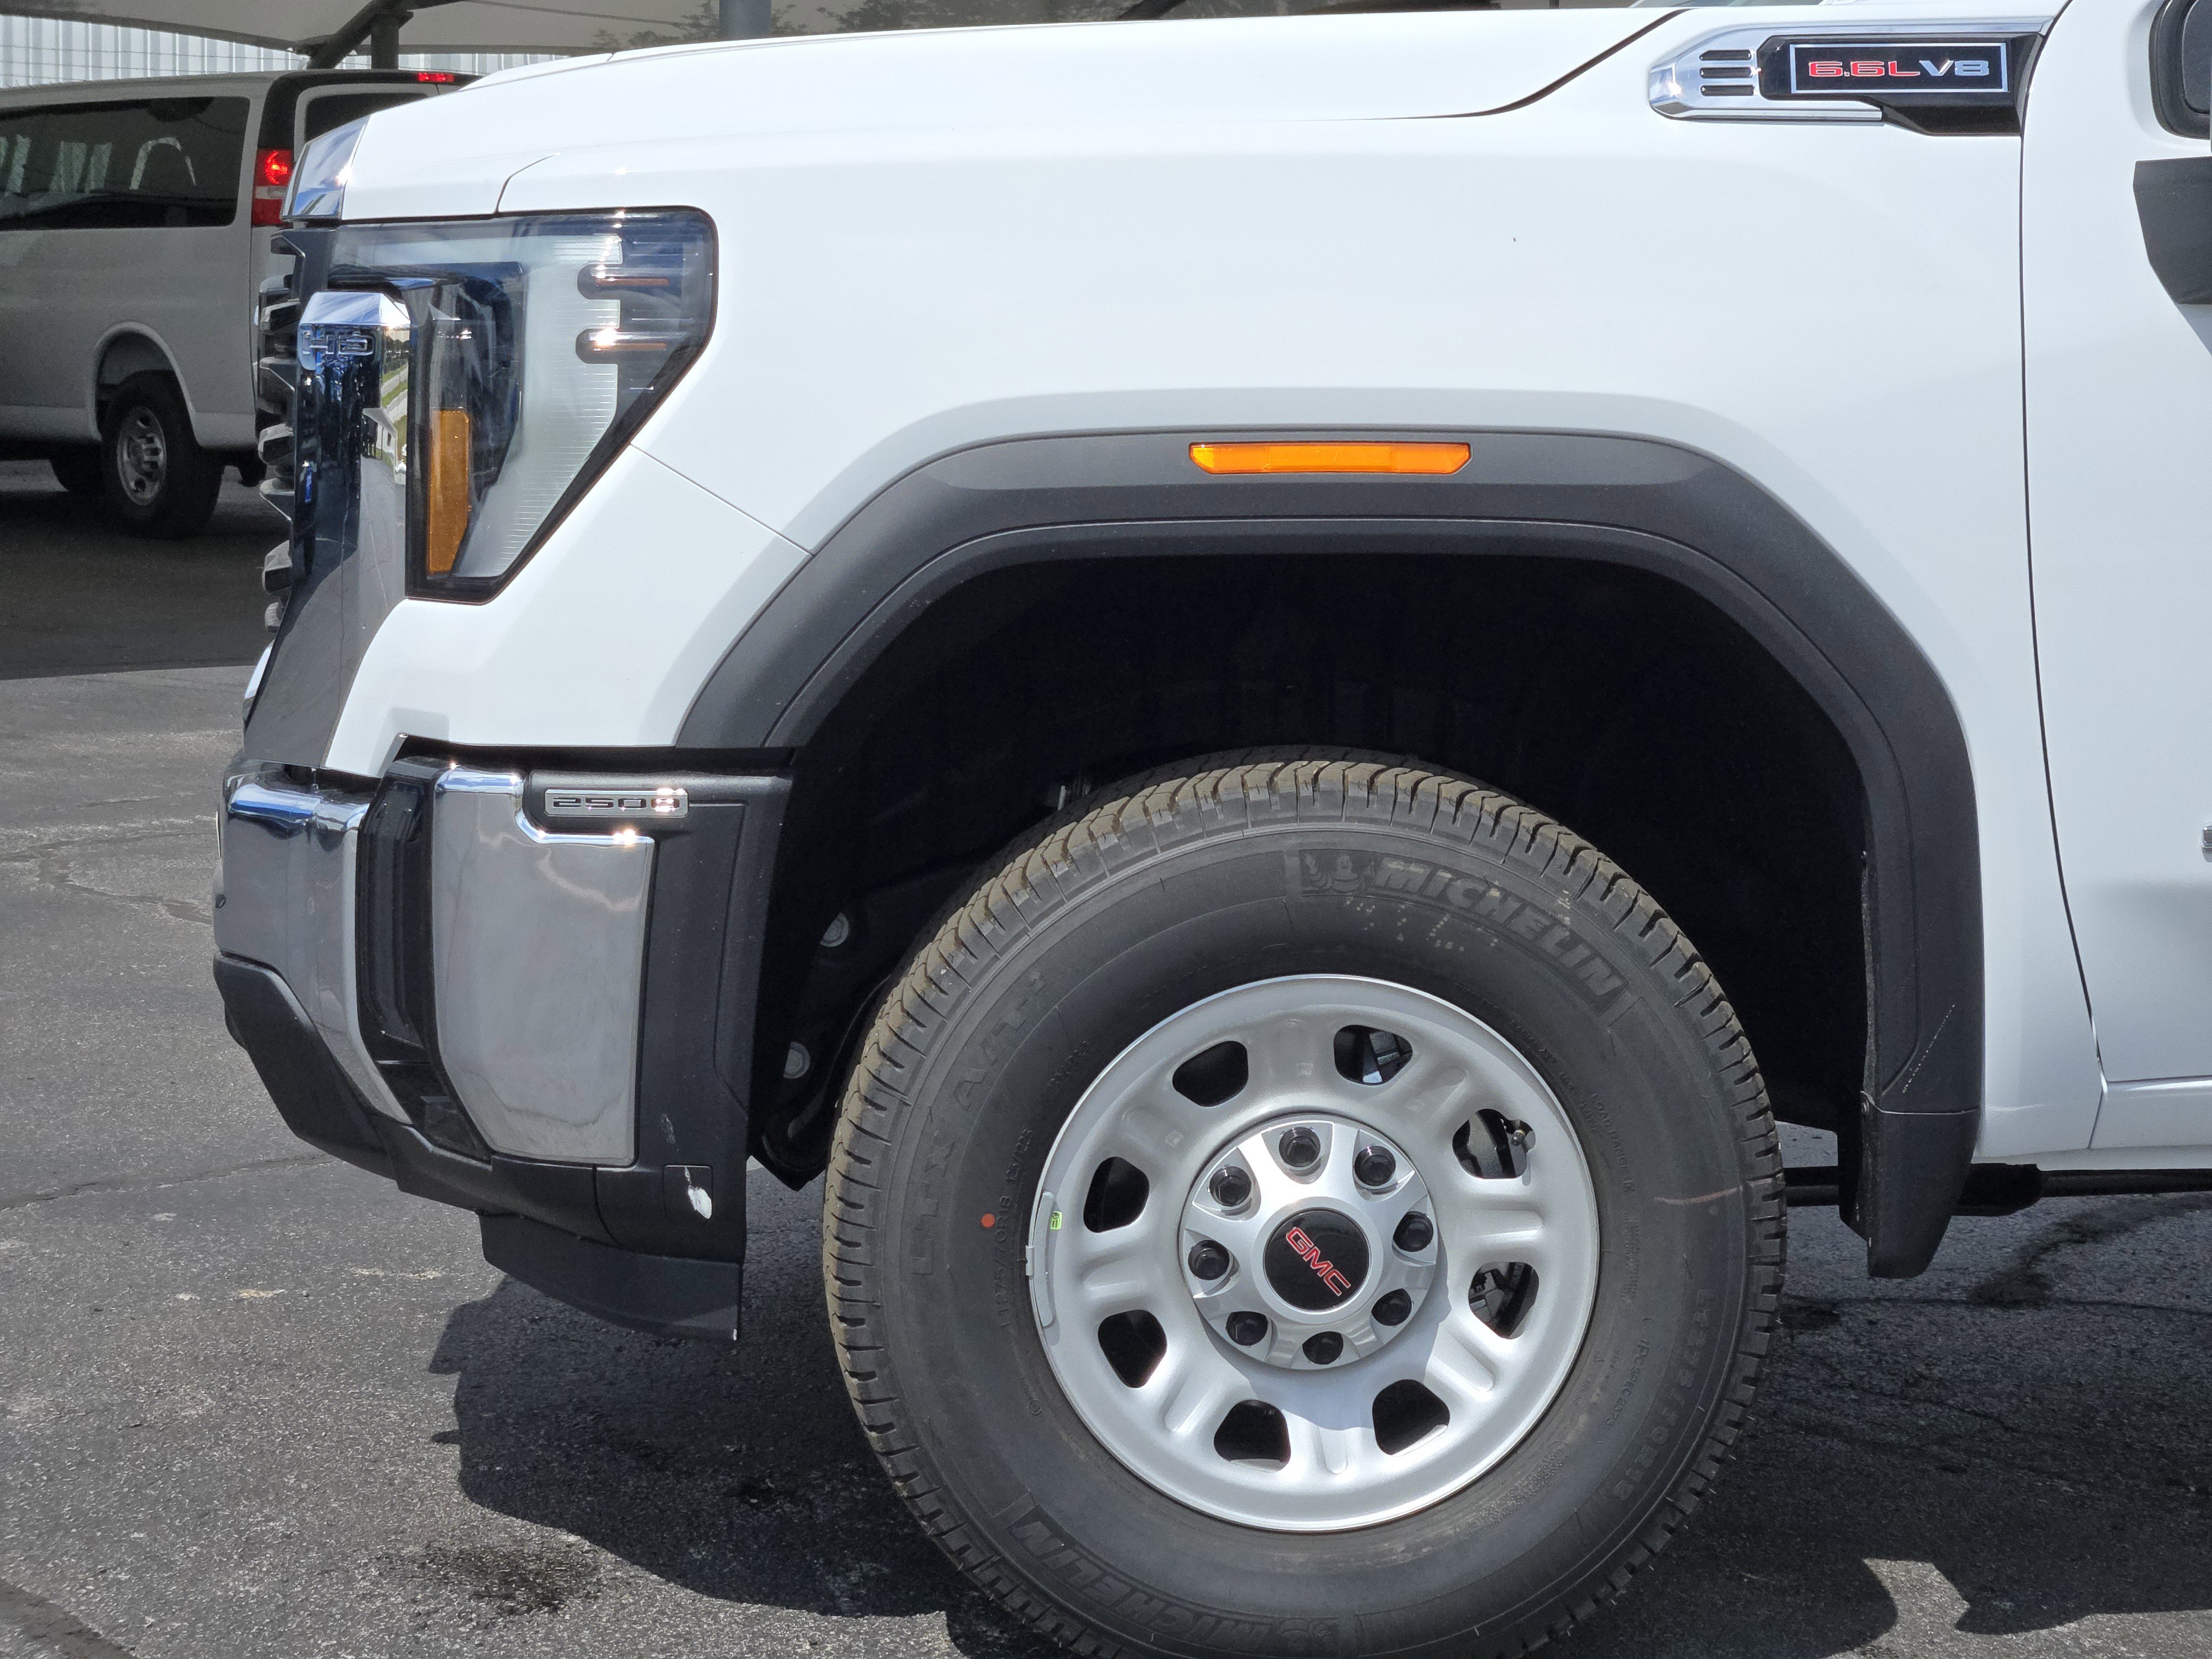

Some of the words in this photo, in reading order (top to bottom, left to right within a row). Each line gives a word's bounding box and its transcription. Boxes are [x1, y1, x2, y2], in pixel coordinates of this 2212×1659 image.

[552, 797, 680, 812] 2500
[1374, 855, 1627, 1000] MICHELIN
[1286, 1227, 1352, 1297] GMC
[1011, 1519, 1269, 1652] MICHELIN
